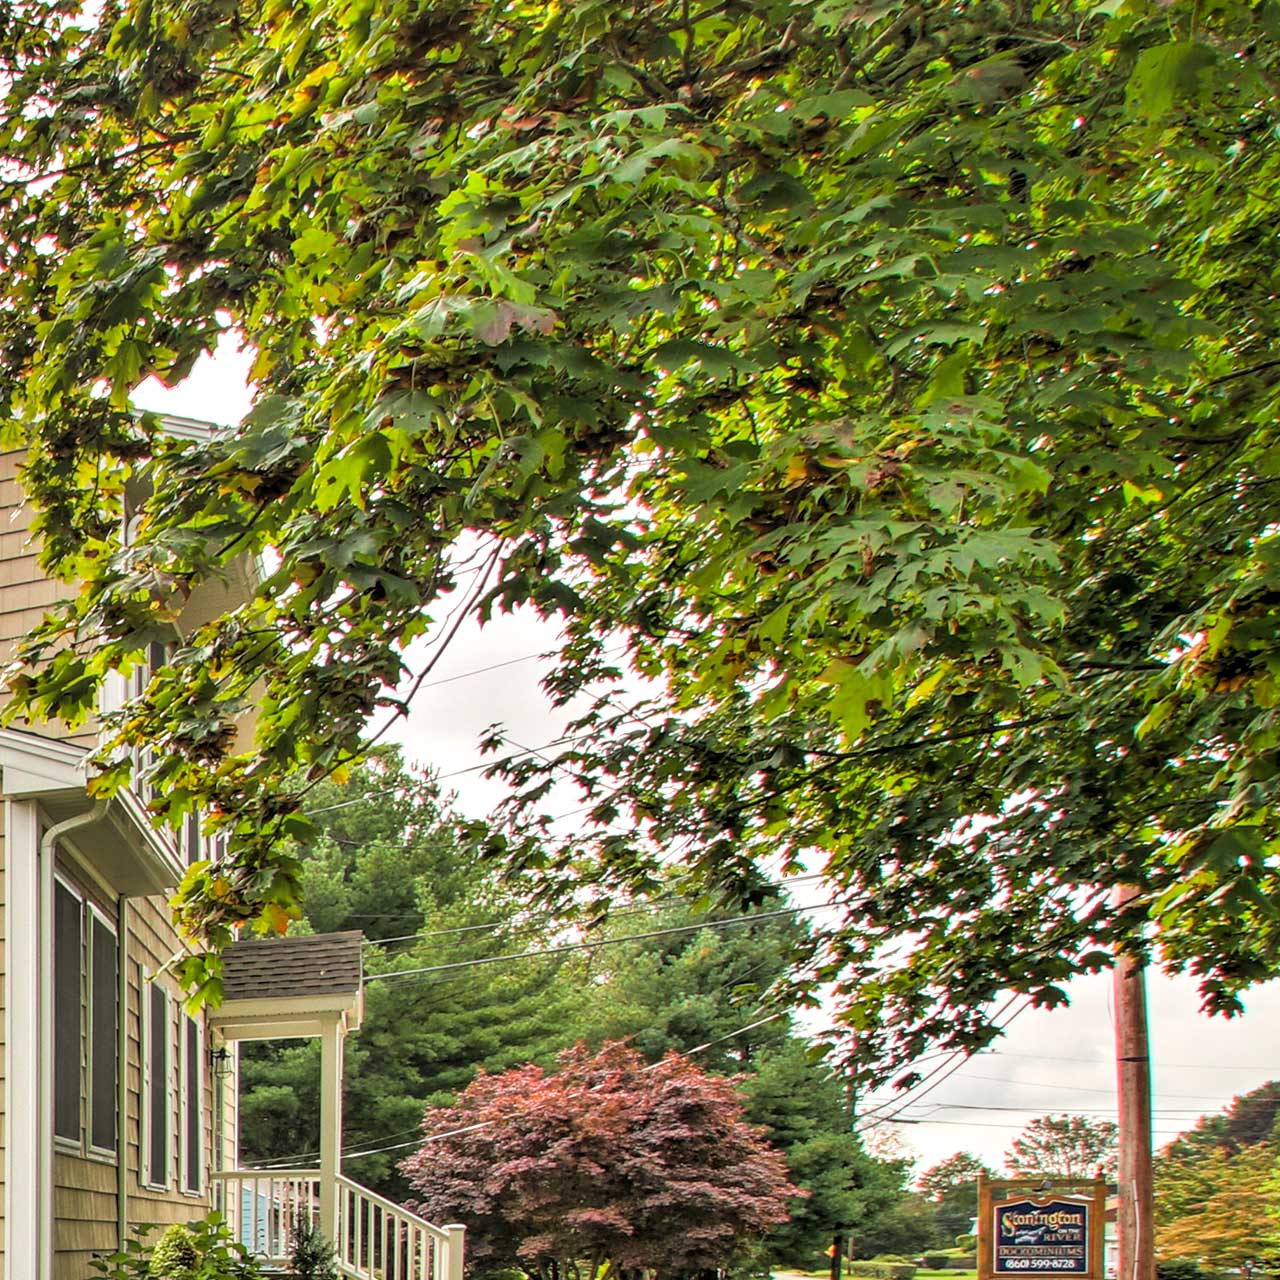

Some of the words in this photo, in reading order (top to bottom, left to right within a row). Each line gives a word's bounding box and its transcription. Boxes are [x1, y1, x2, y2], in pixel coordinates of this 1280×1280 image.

[1001, 1211, 1082, 1237] Stonington
[1043, 1233, 1081, 1241] RIVER
[1000, 1247, 1083, 1256] DOCKOMINIUMS
[1005, 1259, 1029, 1268] (860)
[1030, 1259, 1075, 1268] 599-8728
